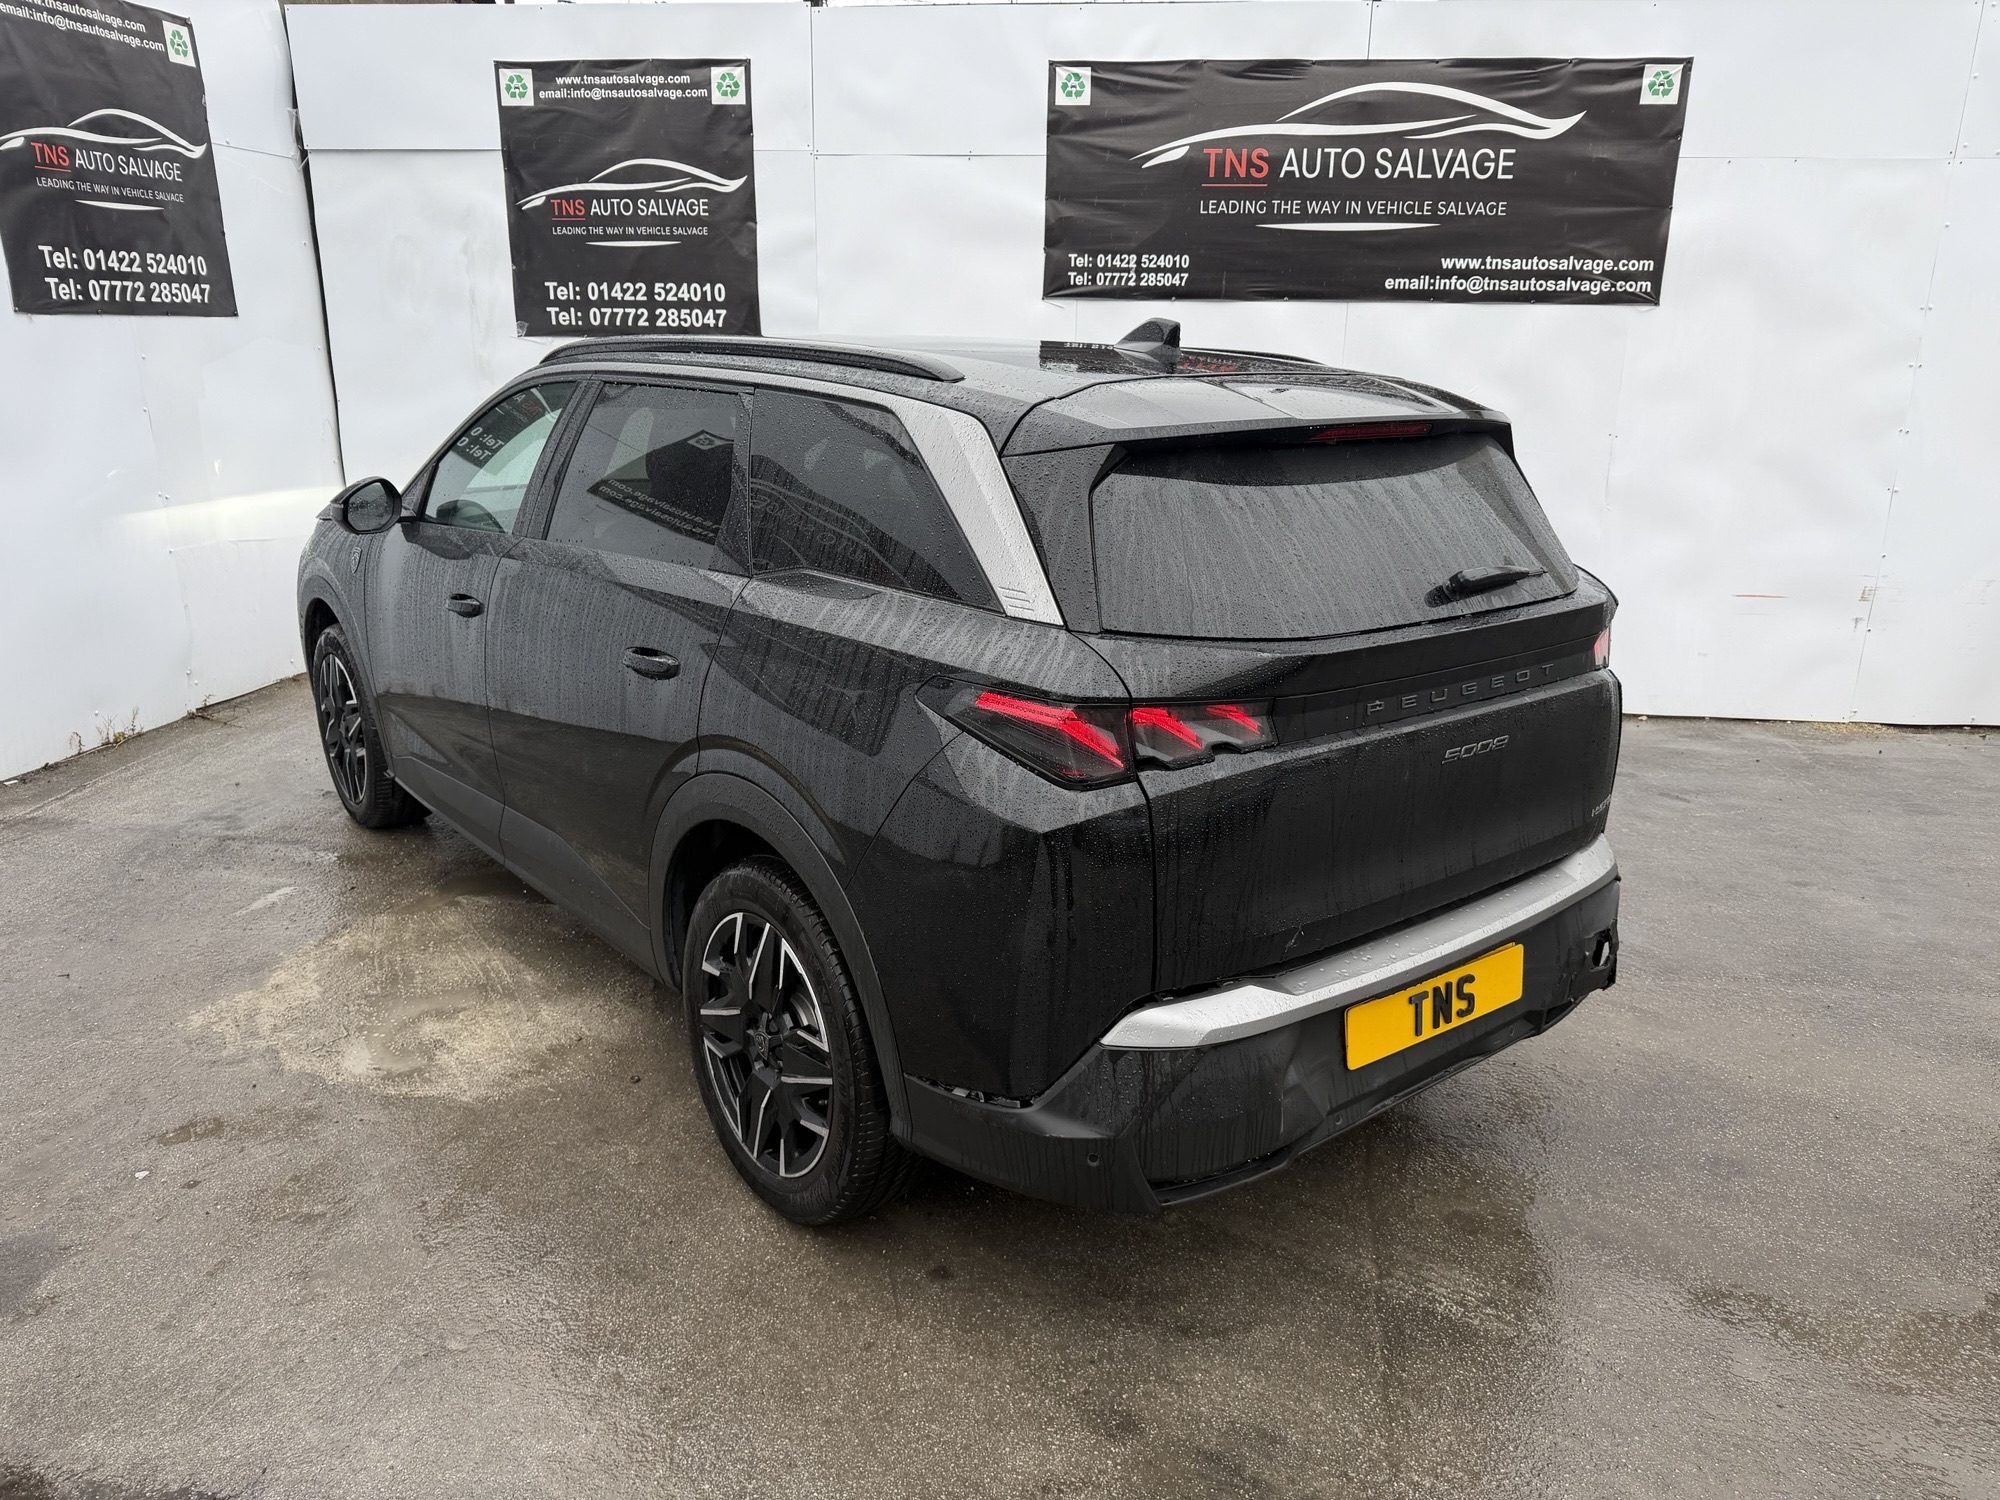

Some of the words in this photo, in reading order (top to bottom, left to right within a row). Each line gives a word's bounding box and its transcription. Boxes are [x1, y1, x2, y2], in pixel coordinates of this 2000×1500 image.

[0, 2, 165, 51] email:info@tnsautosalvage.com
[555, 74, 691, 86] www.tnsautosalvage.com
[539, 87, 708, 100] email:info@tnsautosalvage.com
[31, 142, 70, 167] TNS
[75, 149, 115, 173] AUTO
[117, 155, 183, 182] SALVAGE
[1203, 148, 1270, 178] TNS
[1279, 148, 1366, 179] AUTO
[1374, 148, 1516, 180] SALVAGE
[36, 176, 75, 190] LEADING
[75, 181, 92, 192] THE
[92, 184, 110, 194] WAY
[111, 186, 120, 196] IN
[121, 187, 154, 200] VEHICLE
[154, 190, 185, 203] SALVAGE
[550, 199, 586, 216] TNS
[590, 198, 633, 216] AUTO
[637, 198, 709, 216] SALVAGE
[1199, 200, 1267, 215] LEADING
[1272, 200, 1301, 215] THE
[1306, 200, 1341, 215] WAY
[1345, 200, 1361, 215] IN
[1366, 200, 1433, 215] VEHICLE
[1437, 201, 1508, 216] SALVAGE
[552, 226, 587, 235] LEADING
[588, 226, 604, 235] THE
[605, 226, 624, 235] WAY
[625, 226, 635, 235] IN
[636, 226, 671, 236] VEHICLE
[672, 226, 709, 236] SALVAGE
[38, 245, 79, 270] Tel:
[83, 248, 143, 273] 01422
[146, 252, 207, 276] 524010
[1068, 253, 1093, 268] Tel:
[1096, 253, 1137, 268] 01422
[1140, 254, 1190, 268] 524010
[1441, 256, 1654, 274] www.tnsautosalvage.com
[1067, 272, 1092, 286] Tel:
[1096, 272, 1136, 286] 07772
[1139, 272, 1189, 287] 285047
[1384, 275, 1651, 295] email:info@tnsautosalvage.com
[44, 277, 83, 301] Tel:
[88, 279, 146, 302] 07772
[150, 281, 211, 304] 285047
[544, 281, 581, 300] Tel:
[587, 281, 648, 301] 01422
[654, 282, 726, 302] 524010
[546, 307, 583, 326] Tel:
[589, 307, 650, 326] 07772
[655, 308, 727, 328] 285047
[1366, 663, 1554, 716] PEUGEOT
[1441, 735, 1509, 765] 5008
[1409, 973, 1475, 1037] TNS
